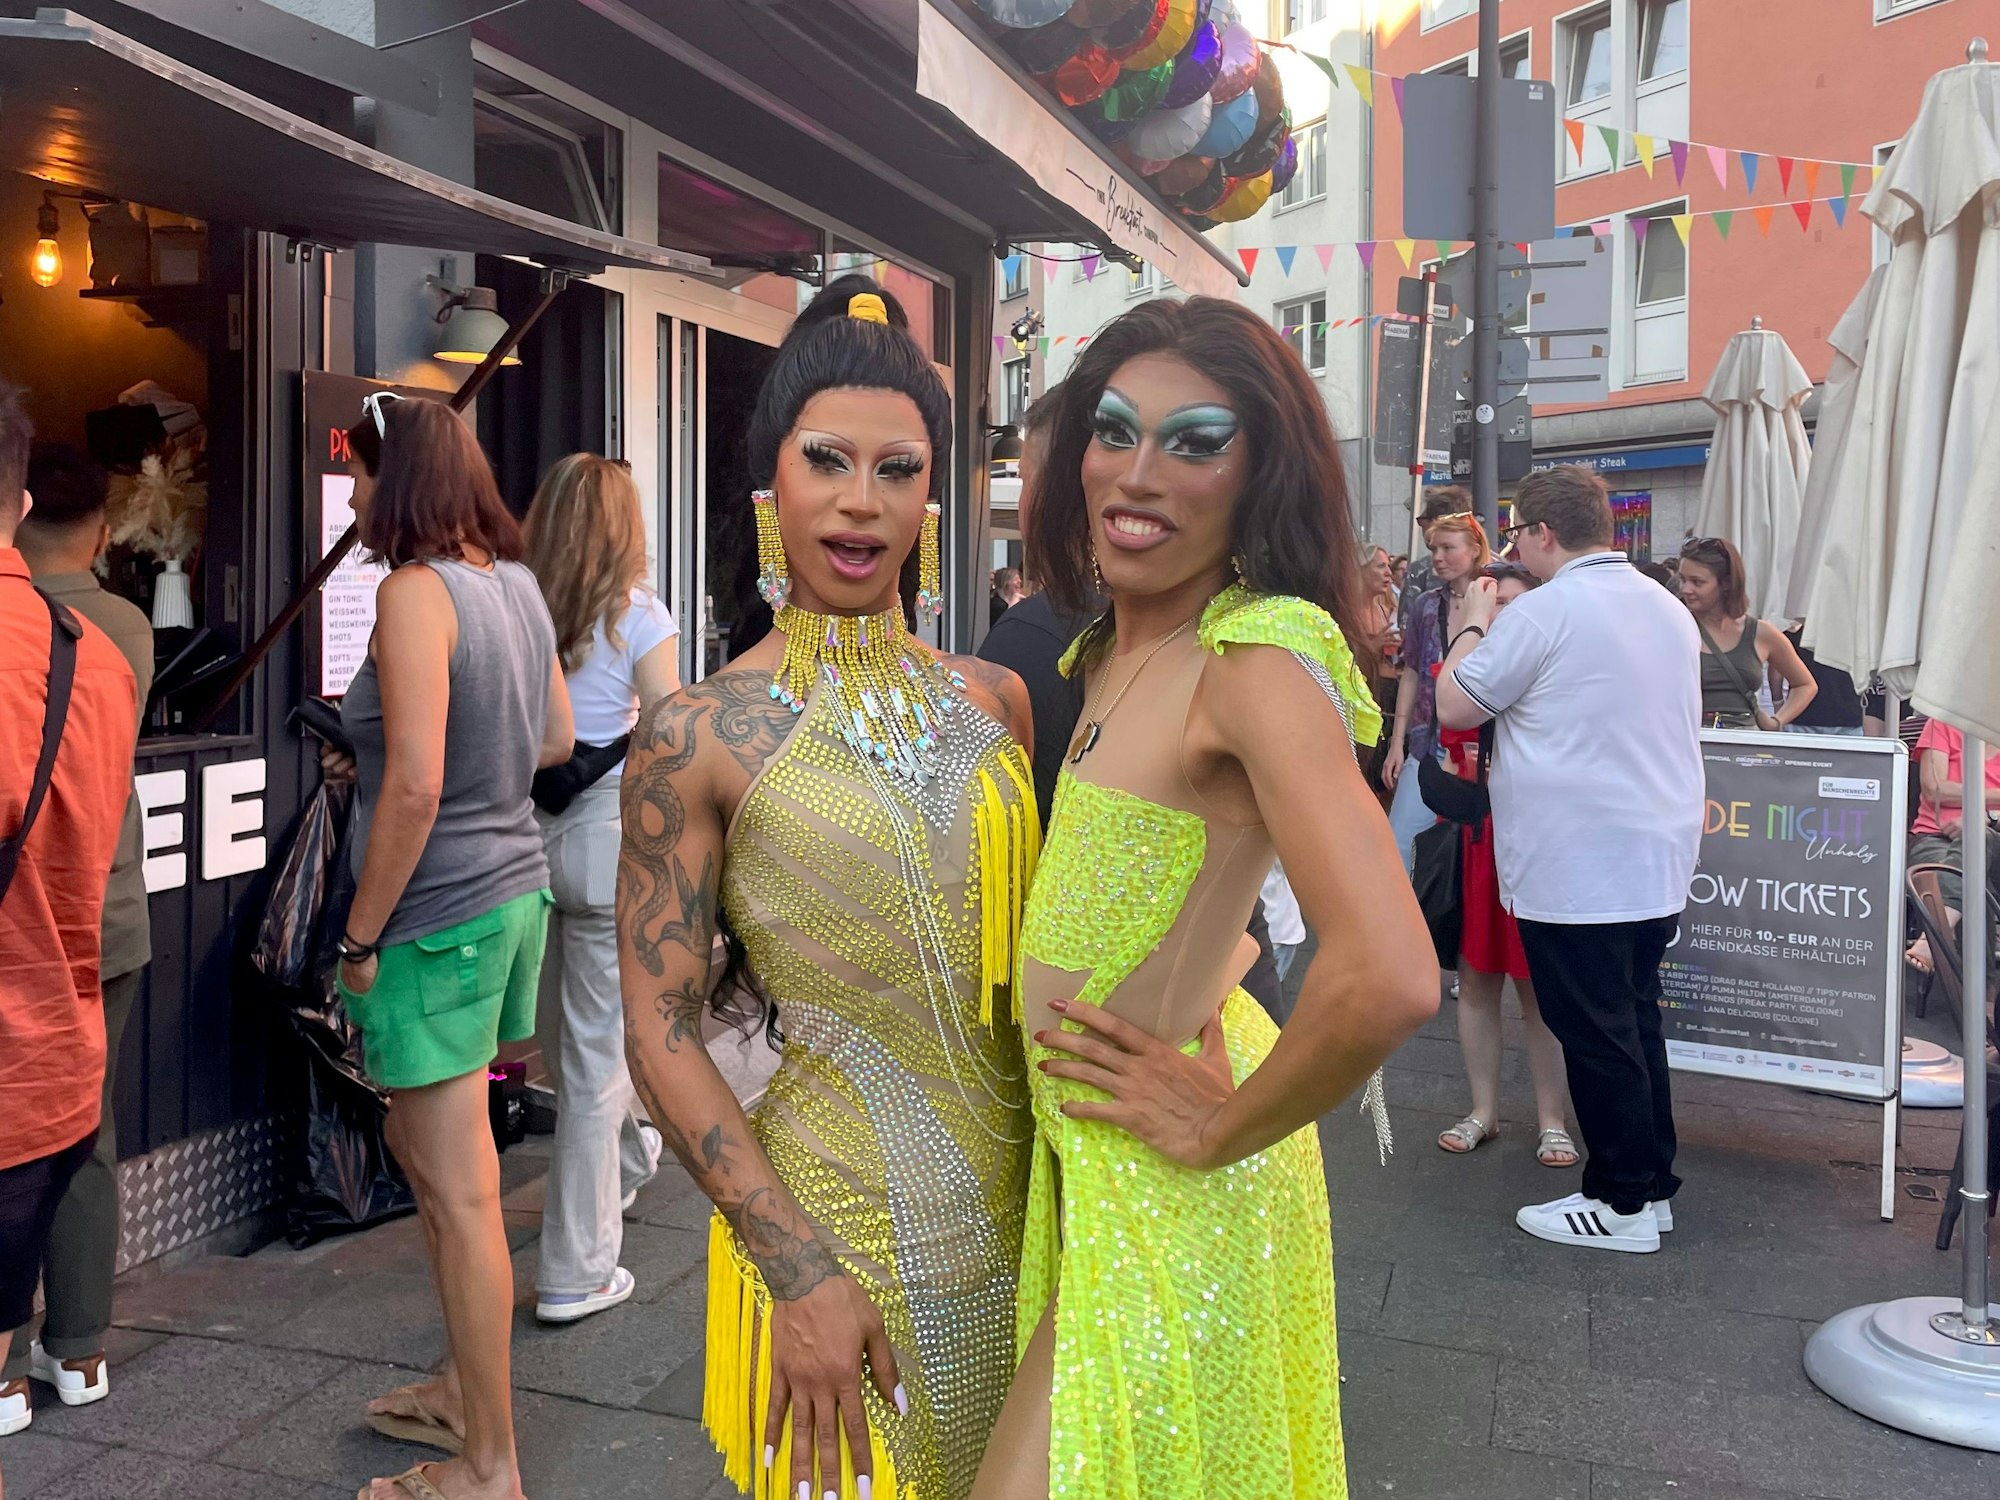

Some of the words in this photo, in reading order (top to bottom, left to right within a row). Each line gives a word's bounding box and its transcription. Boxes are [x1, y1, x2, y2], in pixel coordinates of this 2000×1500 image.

[1600, 456, 1627, 468] Steak
[329, 574, 352, 583] QUEER
[329, 595, 341, 604] GIN
[343, 595, 363, 603] TONIC
[329, 607, 366, 616] WEISSWEIN
[329, 633, 352, 642] SHOTS
[329, 654, 351, 663] SOFTS
[329, 666, 355, 675] WASSER
[329, 680, 342, 689] RED
[1766, 803, 1870, 846] NIGHT
[1805, 836, 1878, 864] Unholy
[1756, 878, 1872, 919] TICKETS
[1691, 923, 1722, 936] HIER
[1725, 925, 1752, 940] FÜR
[1788, 933, 1818, 946] EUR
[1821, 936, 1841, 948] AN
[1845, 938, 1874, 951] DER
[1690, 938, 1778, 957] ABENDKASSE
[1782, 948, 1866, 966] ERHÄLTLICH
[1667, 971, 1689, 980] ABBY
[1738, 979, 1760, 988] RACE
[1816, 987, 1841, 997] TIPSY
[1842, 990, 1876, 1001] PATRON
[1711, 985, 1736, 994] PUMA
[1737, 988, 1766, 998] HILTON
[1700, 993, 1736, 1004] FRIENDS
[1703, 1005, 1726, 1015] LANA
[1727, 1008, 1771, 1020] DELICIOUS
